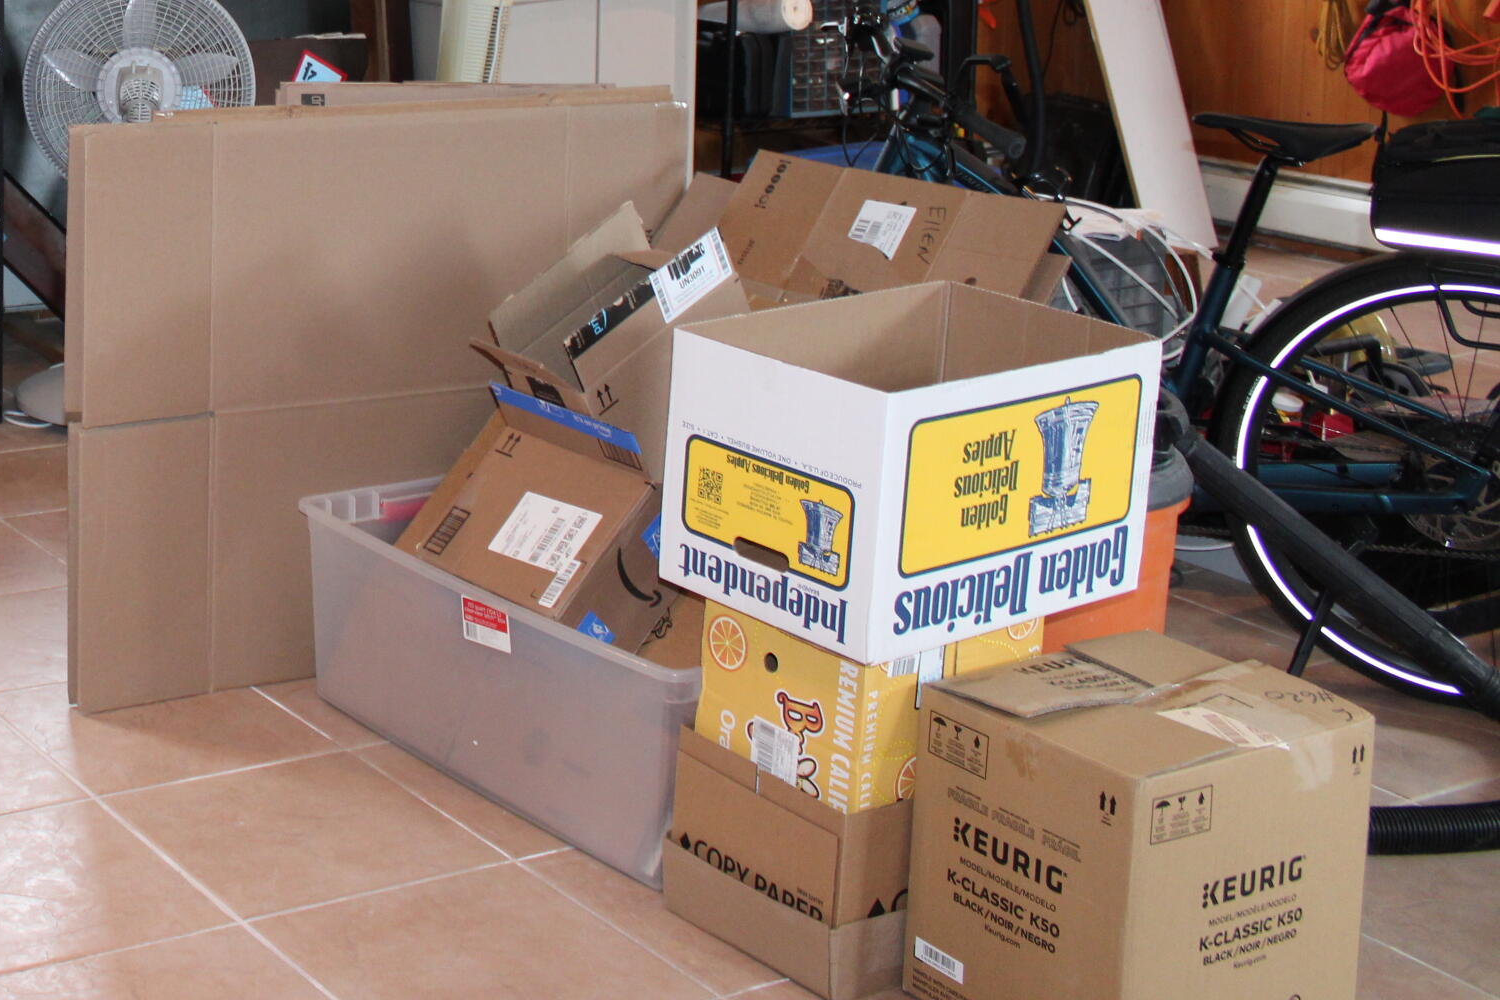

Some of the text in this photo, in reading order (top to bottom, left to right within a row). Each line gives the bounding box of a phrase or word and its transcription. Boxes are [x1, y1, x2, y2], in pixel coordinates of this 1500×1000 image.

[677, 264, 707, 291] UN3091
[962, 429, 1017, 466] Apples
[726, 454, 810, 494] Golden Delicious Apples
[954, 460, 1019, 498] Delicious
[961, 494, 1008, 530] Golden
[678, 543, 848, 644] Independent
[893, 525, 1128, 635] Golden Delicious
[718, 709, 736, 750] Ora
[828, 660, 860, 815] REMIUM CALIF
[859, 690, 879, 809] PREMIUM CALI
[694, 839, 750, 882] COPY
[954, 816, 1064, 894] KEURIG
[947, 867, 1061, 938] K-CLASSIC K50
[1202, 855, 1303, 909] KEURIG
[1199, 907, 1303, 952] K-CLASSIC K50
